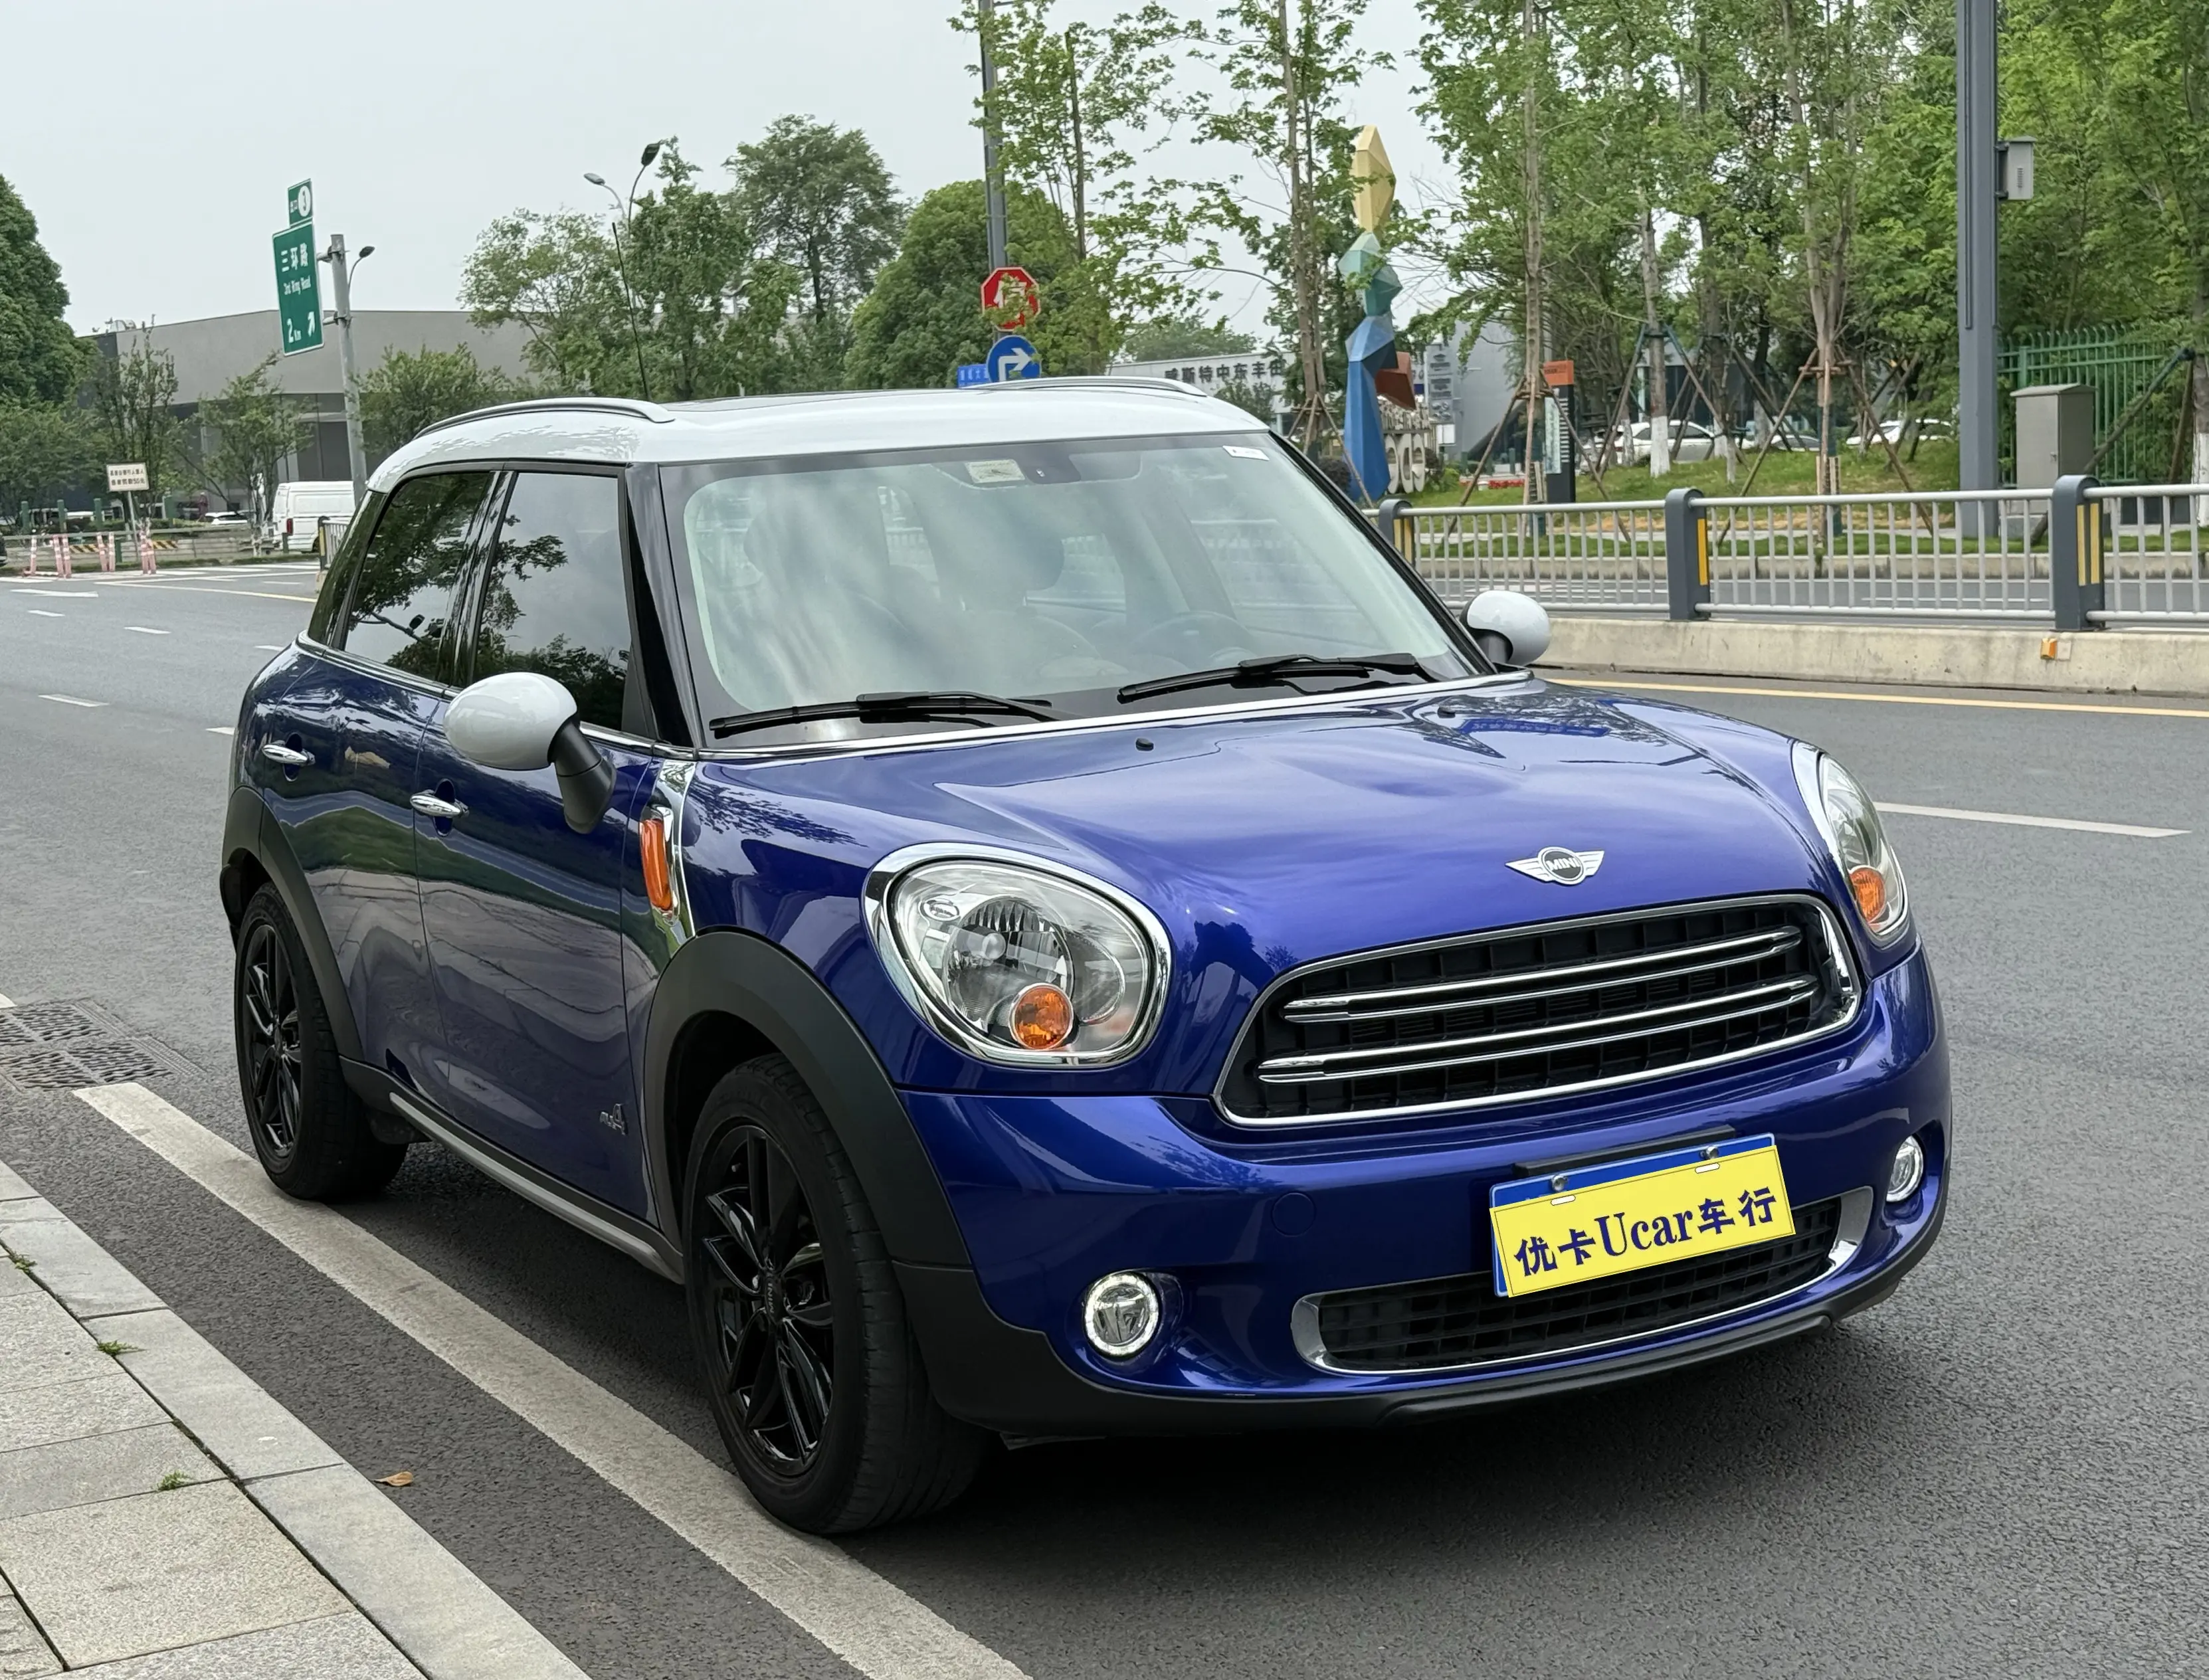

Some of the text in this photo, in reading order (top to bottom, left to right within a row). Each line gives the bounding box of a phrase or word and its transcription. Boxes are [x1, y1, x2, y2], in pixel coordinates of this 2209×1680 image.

[281, 242, 308, 272] 三环路
[1546, 857, 1581, 871] MINI
